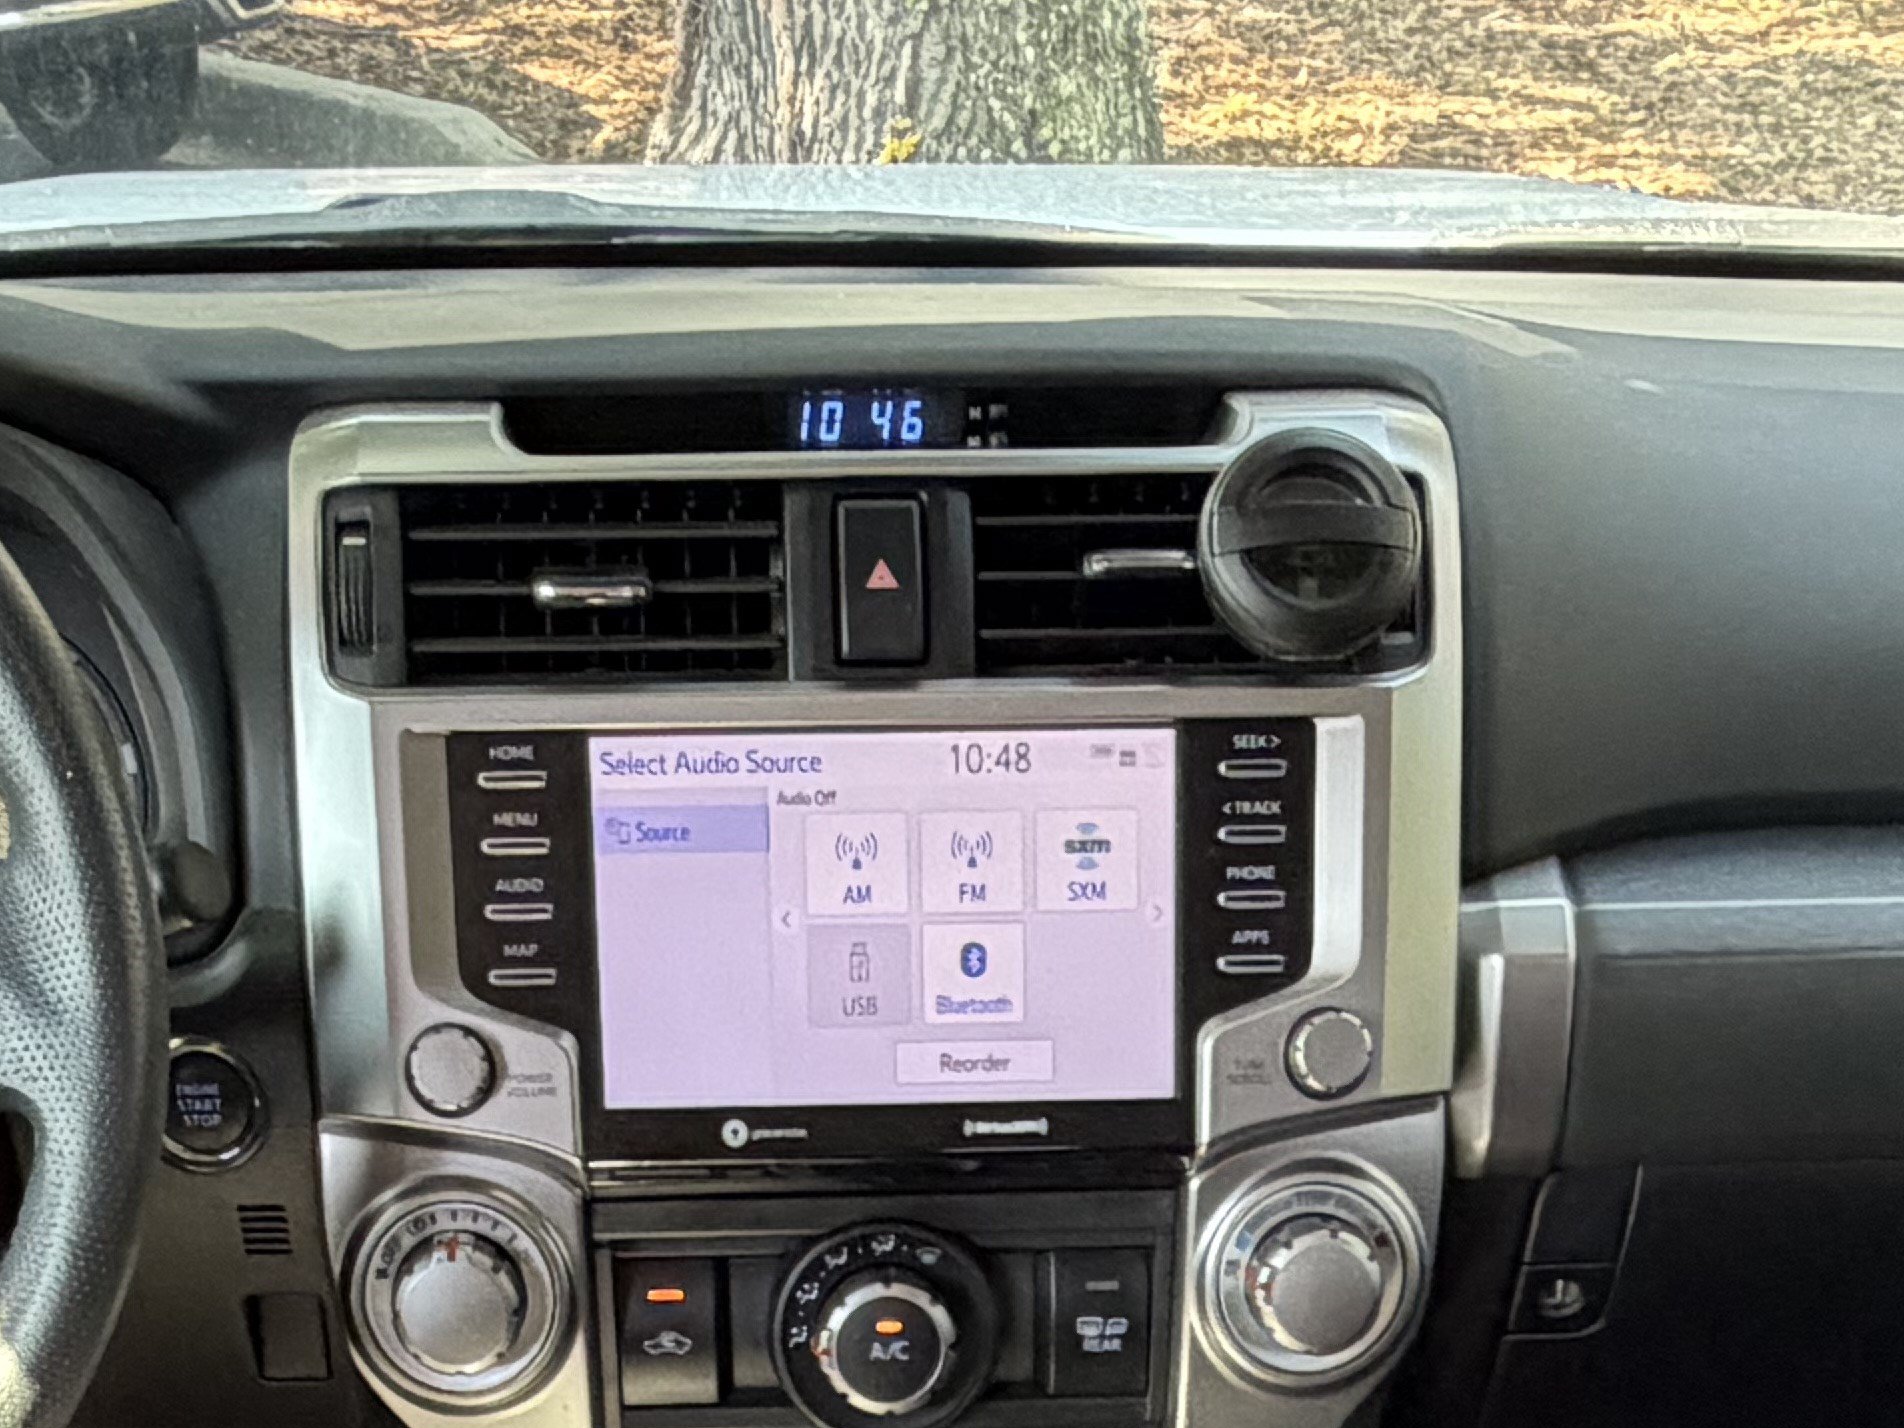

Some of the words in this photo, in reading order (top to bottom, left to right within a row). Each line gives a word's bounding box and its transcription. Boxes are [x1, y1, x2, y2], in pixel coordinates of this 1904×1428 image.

[488, 744, 535, 760] HOME
[951, 742, 1032, 774] 10:48
[599, 750, 667, 777] Select
[674, 750, 741, 775] Audio
[745, 749, 823, 775] Source
[776, 790, 812, 806] Audio
[814, 789, 837, 805] Off
[492, 812, 538, 828] MENU
[634, 821, 691, 843] Source
[1225, 865, 1276, 880] PHONE
[495, 877, 545, 893] AUDIO
[842, 884, 872, 904] AM
[958, 882, 986, 903] FM
[1066, 880, 1107, 901] SXM
[1231, 929, 1270, 945] APPS
[502, 943, 539, 957] MAP
[841, 994, 878, 1017] USB
[935, 994, 1014, 1016] Bluetooth
[939, 1053, 1011, 1074] Reorder
[176, 1098, 222, 1112] START
[183, 1114, 223, 1128] STOP
[868, 1340, 910, 1361] A/C
